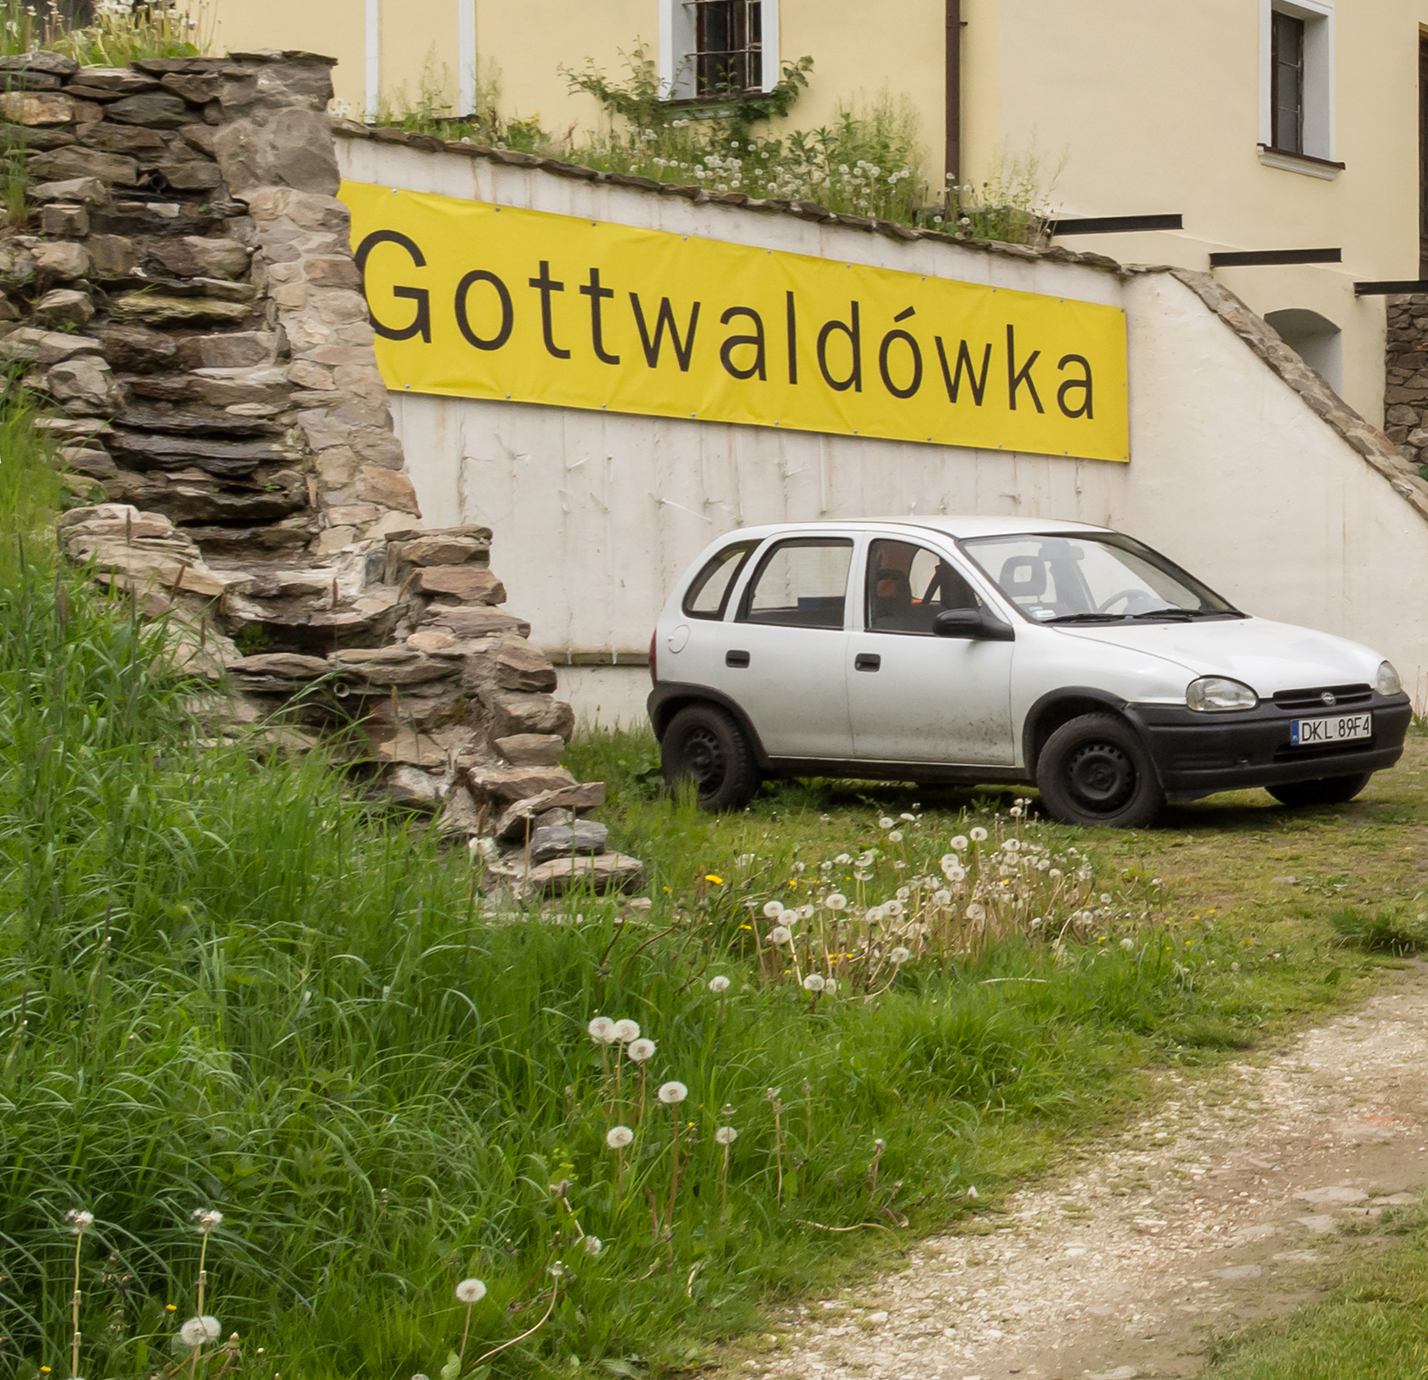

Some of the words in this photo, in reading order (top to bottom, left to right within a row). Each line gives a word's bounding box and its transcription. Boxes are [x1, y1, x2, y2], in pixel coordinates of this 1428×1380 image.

[354, 229, 1095, 420] Gottwaldówka
[1302, 721, 1333, 741] DKL
[1338, 716, 1369, 737] 89F4
